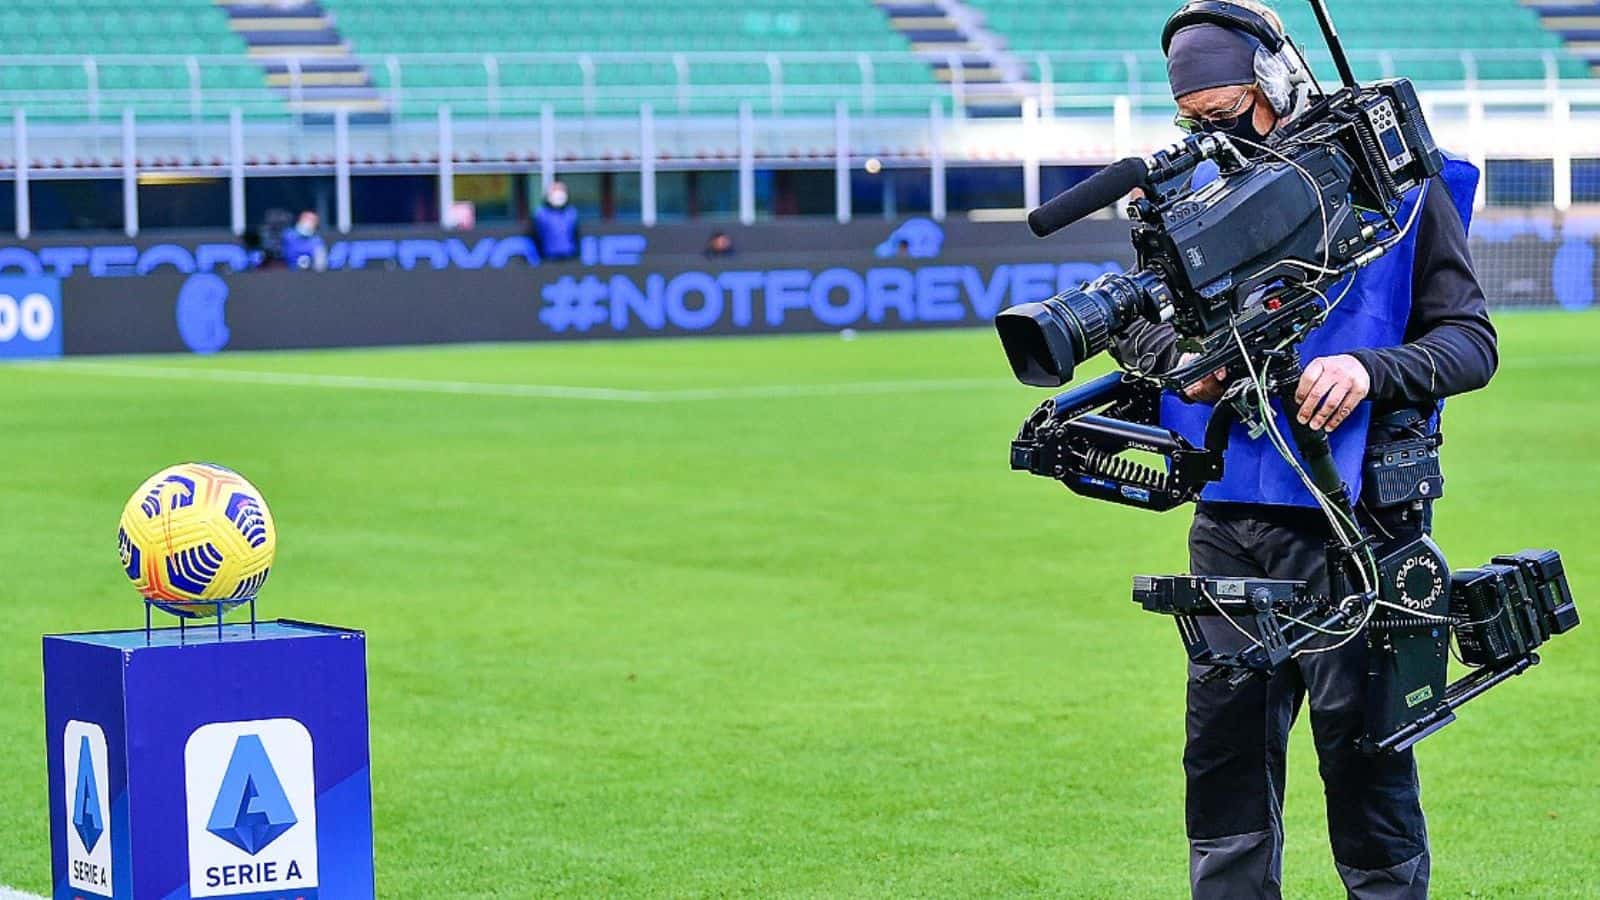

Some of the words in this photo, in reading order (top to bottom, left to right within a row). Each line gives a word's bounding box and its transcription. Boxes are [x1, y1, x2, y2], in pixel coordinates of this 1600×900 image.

[73, 860, 98, 885] SERIE
[101, 866, 108, 888] A
[206, 861, 278, 887] SERIE
[286, 860, 302, 880] A
